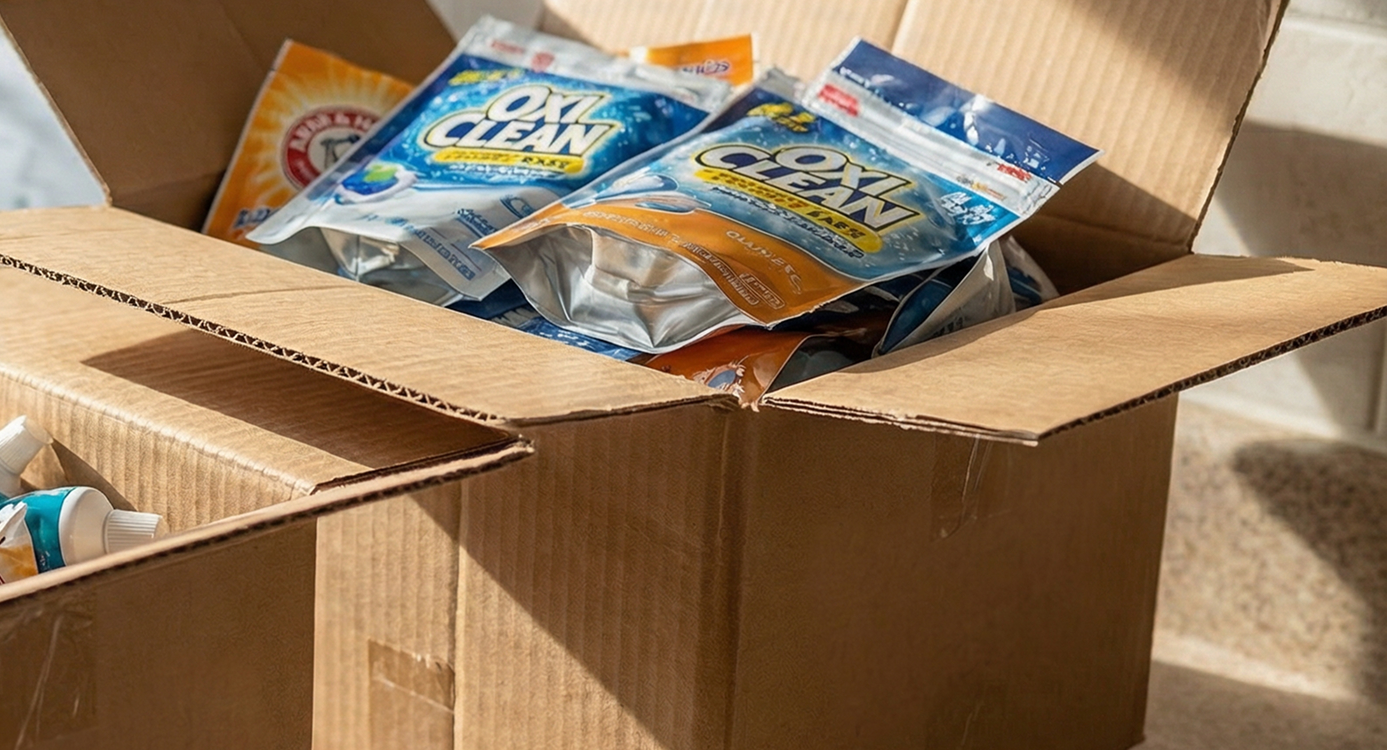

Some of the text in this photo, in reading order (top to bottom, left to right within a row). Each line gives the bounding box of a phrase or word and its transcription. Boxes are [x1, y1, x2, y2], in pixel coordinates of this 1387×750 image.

[487, 85, 604, 124] OXI
[425, 112, 613, 156] CLEAN
[696, 146, 919, 231] CLEAN
[775, 146, 911, 198] OXI
